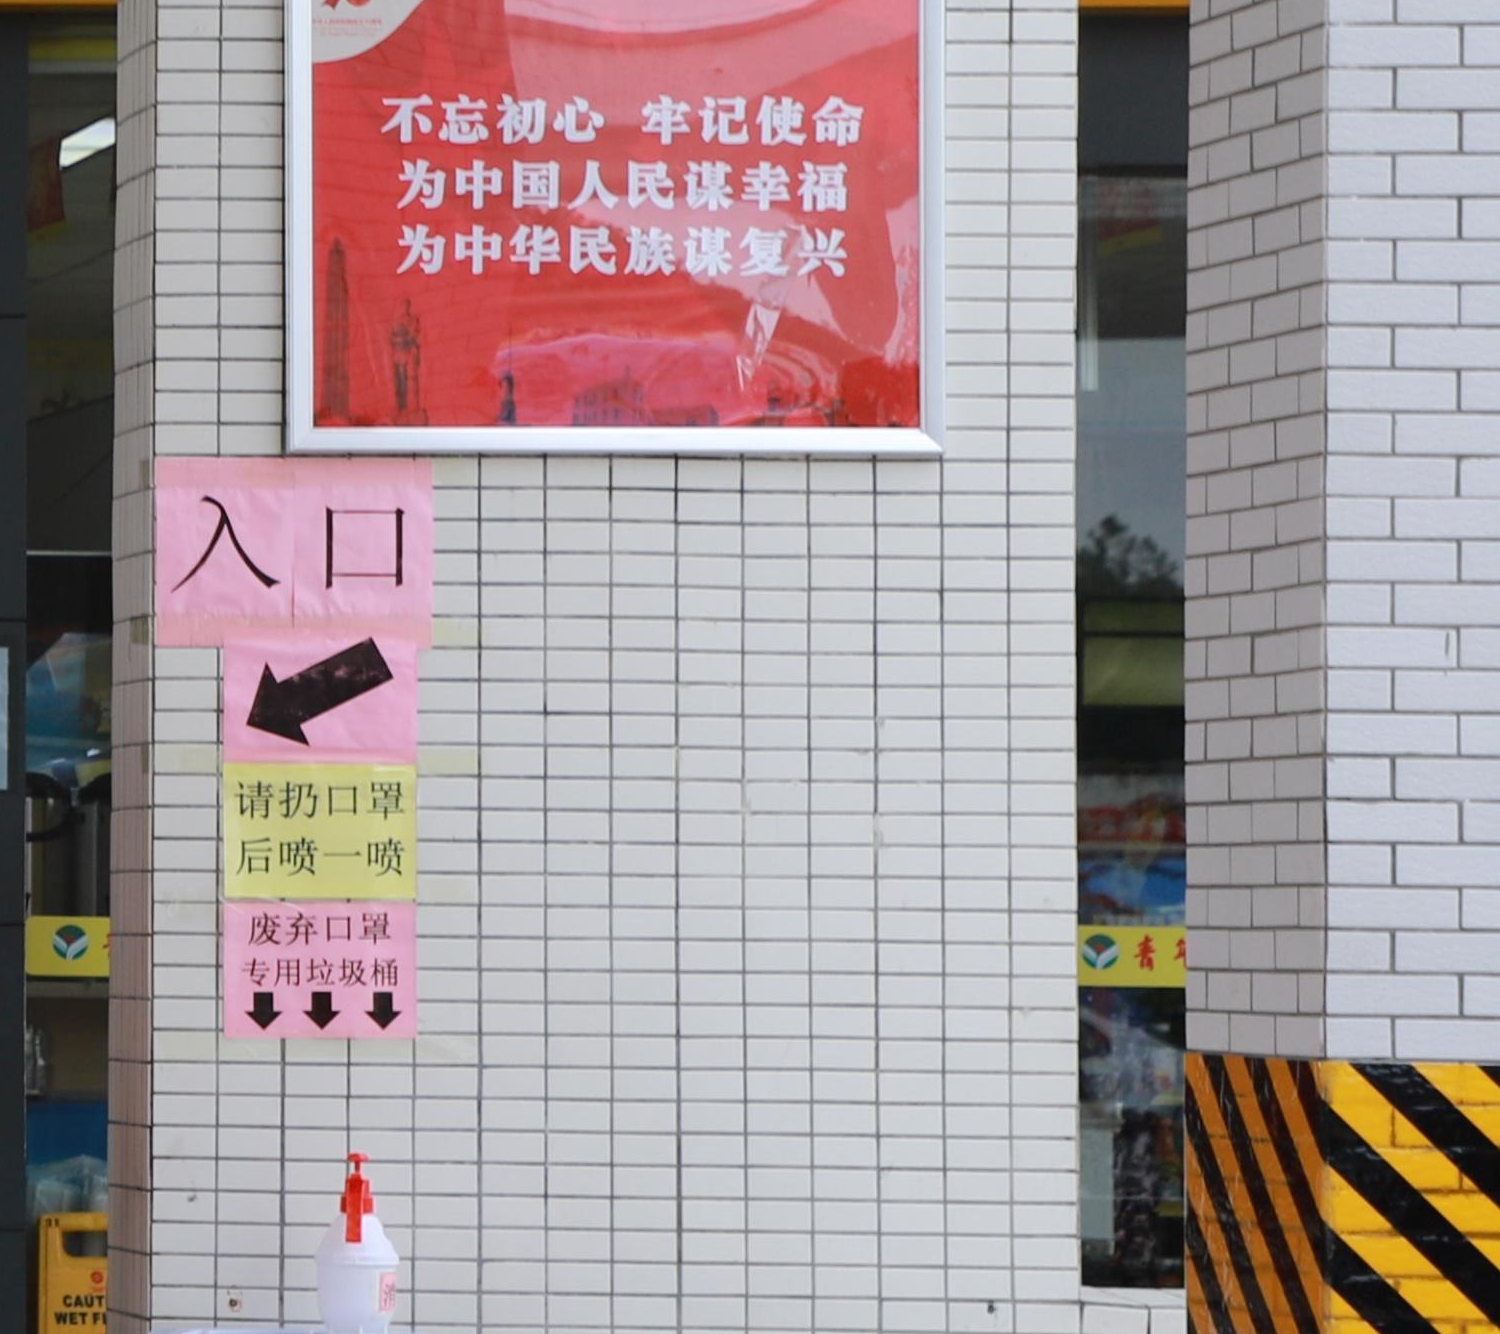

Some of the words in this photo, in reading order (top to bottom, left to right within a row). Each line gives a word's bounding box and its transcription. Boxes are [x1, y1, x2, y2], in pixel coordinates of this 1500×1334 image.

[381, 95, 604, 145] 不忘初心
[641, 94, 864, 145] 牢记使命
[396, 160, 848, 212] 为中国人民谋幸福
[396, 226, 848, 277] 为中华民族谋复兴
[171, 496, 405, 593] 入口
[235, 780, 406, 821] 请扔口罩
[235, 836, 406, 878] 后喷一喷
[248, 912, 392, 947] 废弃口罩
[241, 957, 399, 989] 专用垃圾桶
[54, 1312, 87, 1325] WET
